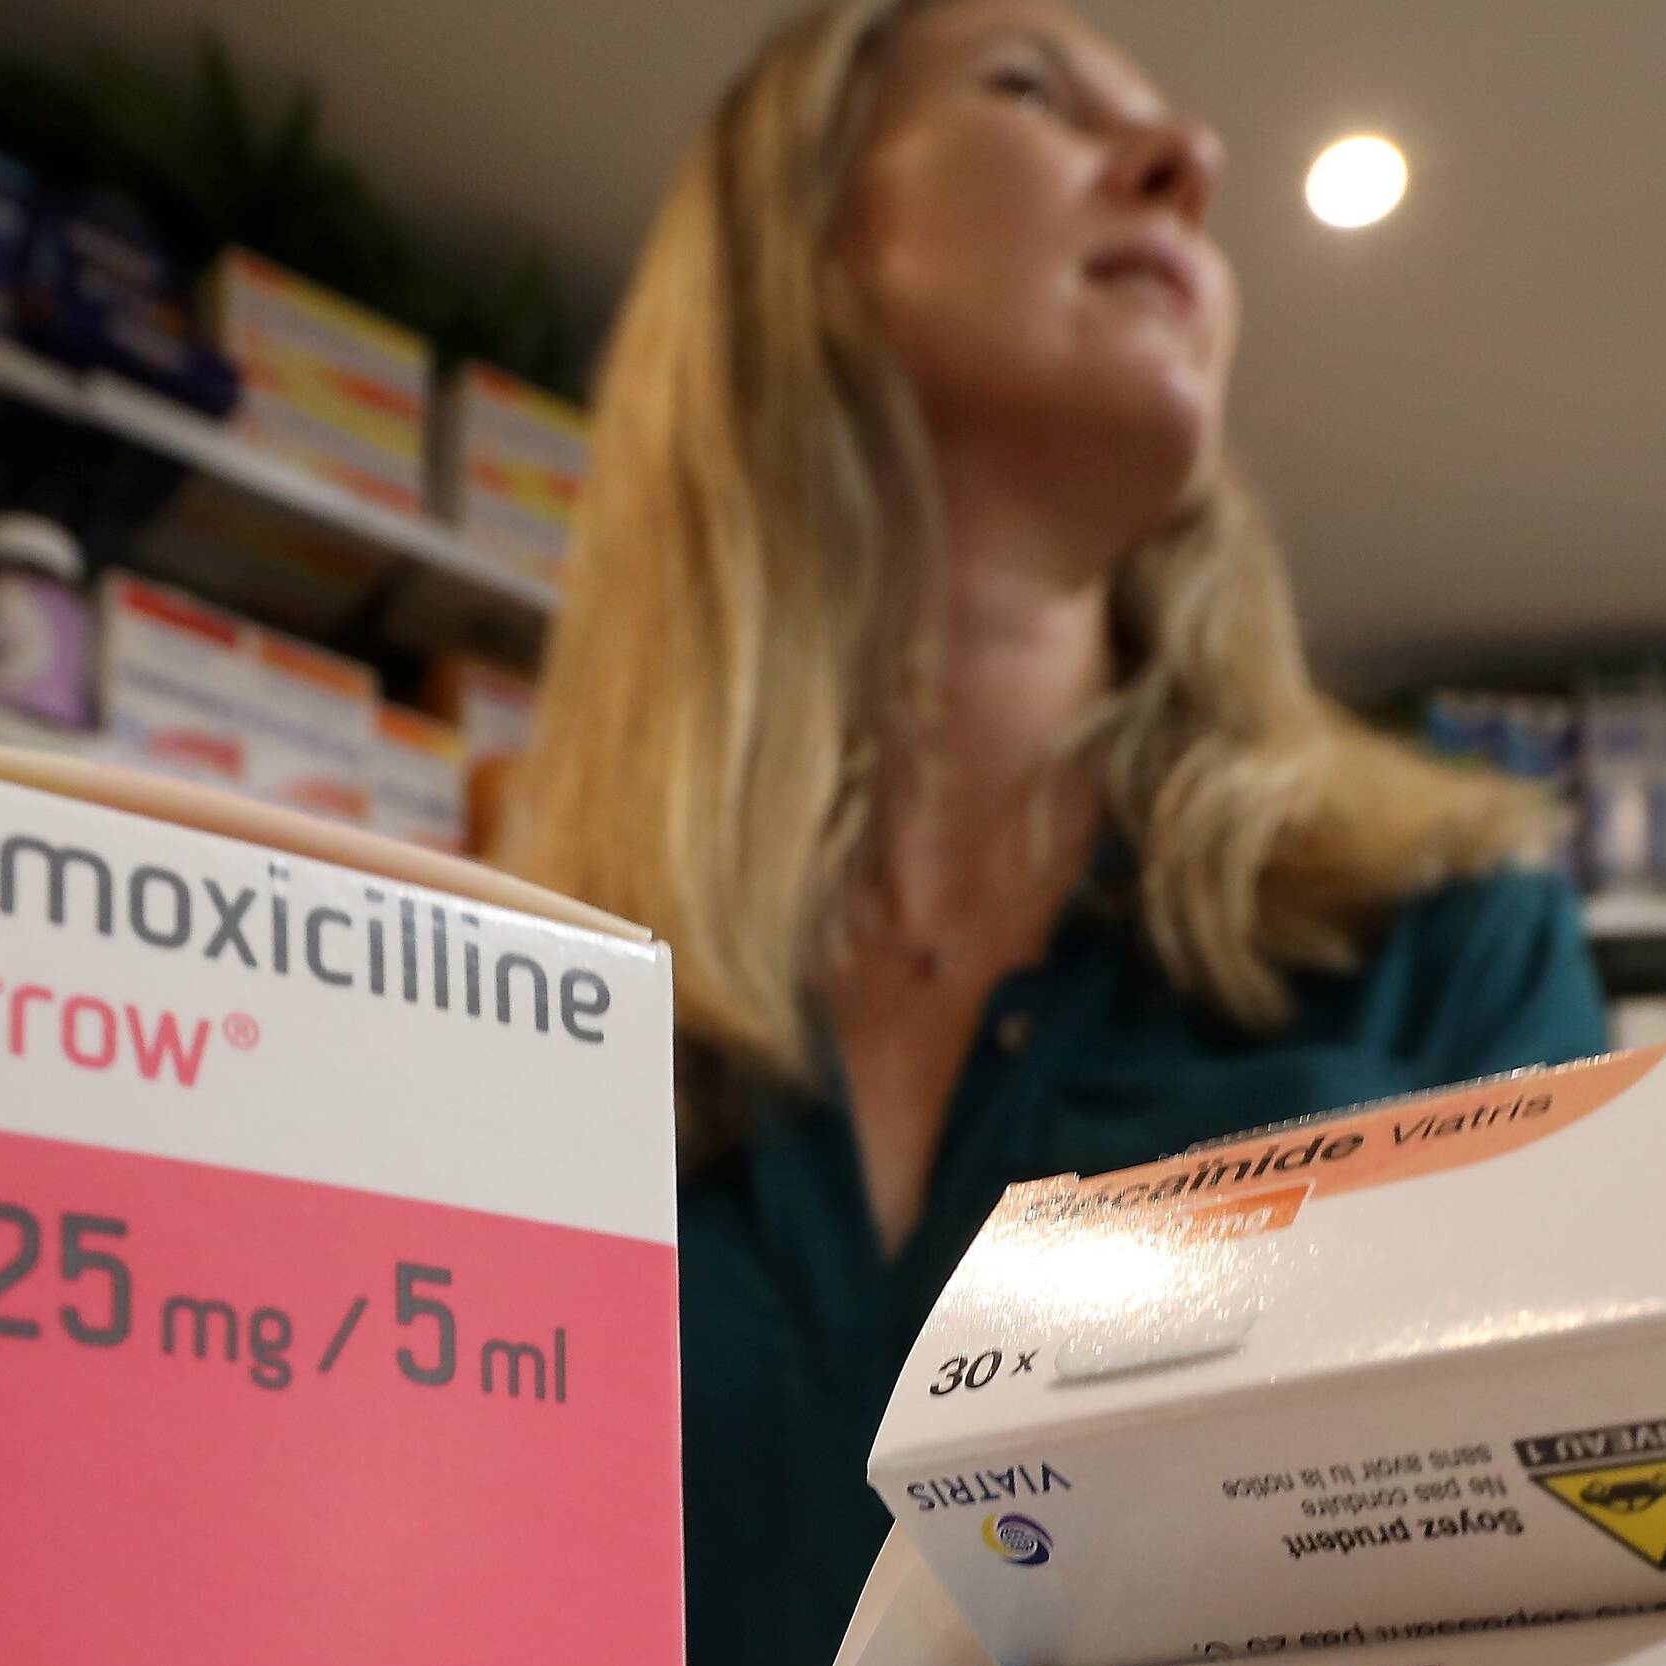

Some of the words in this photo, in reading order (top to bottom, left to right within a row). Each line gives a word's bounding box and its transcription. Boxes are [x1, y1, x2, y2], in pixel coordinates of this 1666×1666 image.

[1391, 1090, 1554, 1149] Viatris
[161, 1293, 294, 1390] mg
[318, 1297, 368, 1375] /
[393, 1263, 457, 1387] 5
[480, 1328, 568, 1405] ml
[929, 1348, 1002, 1397] 30
[1362, 1449, 1424, 1477] avoir
[1429, 1441, 1494, 1469] sans
[906, 1460, 1073, 1514] VIATRIS
[1221, 1471, 1295, 1501] notice
[1300, 1483, 1409, 1519] conduire
[1284, 1513, 1413, 1560] prudent
[1423, 1504, 1526, 1540] Soyez
